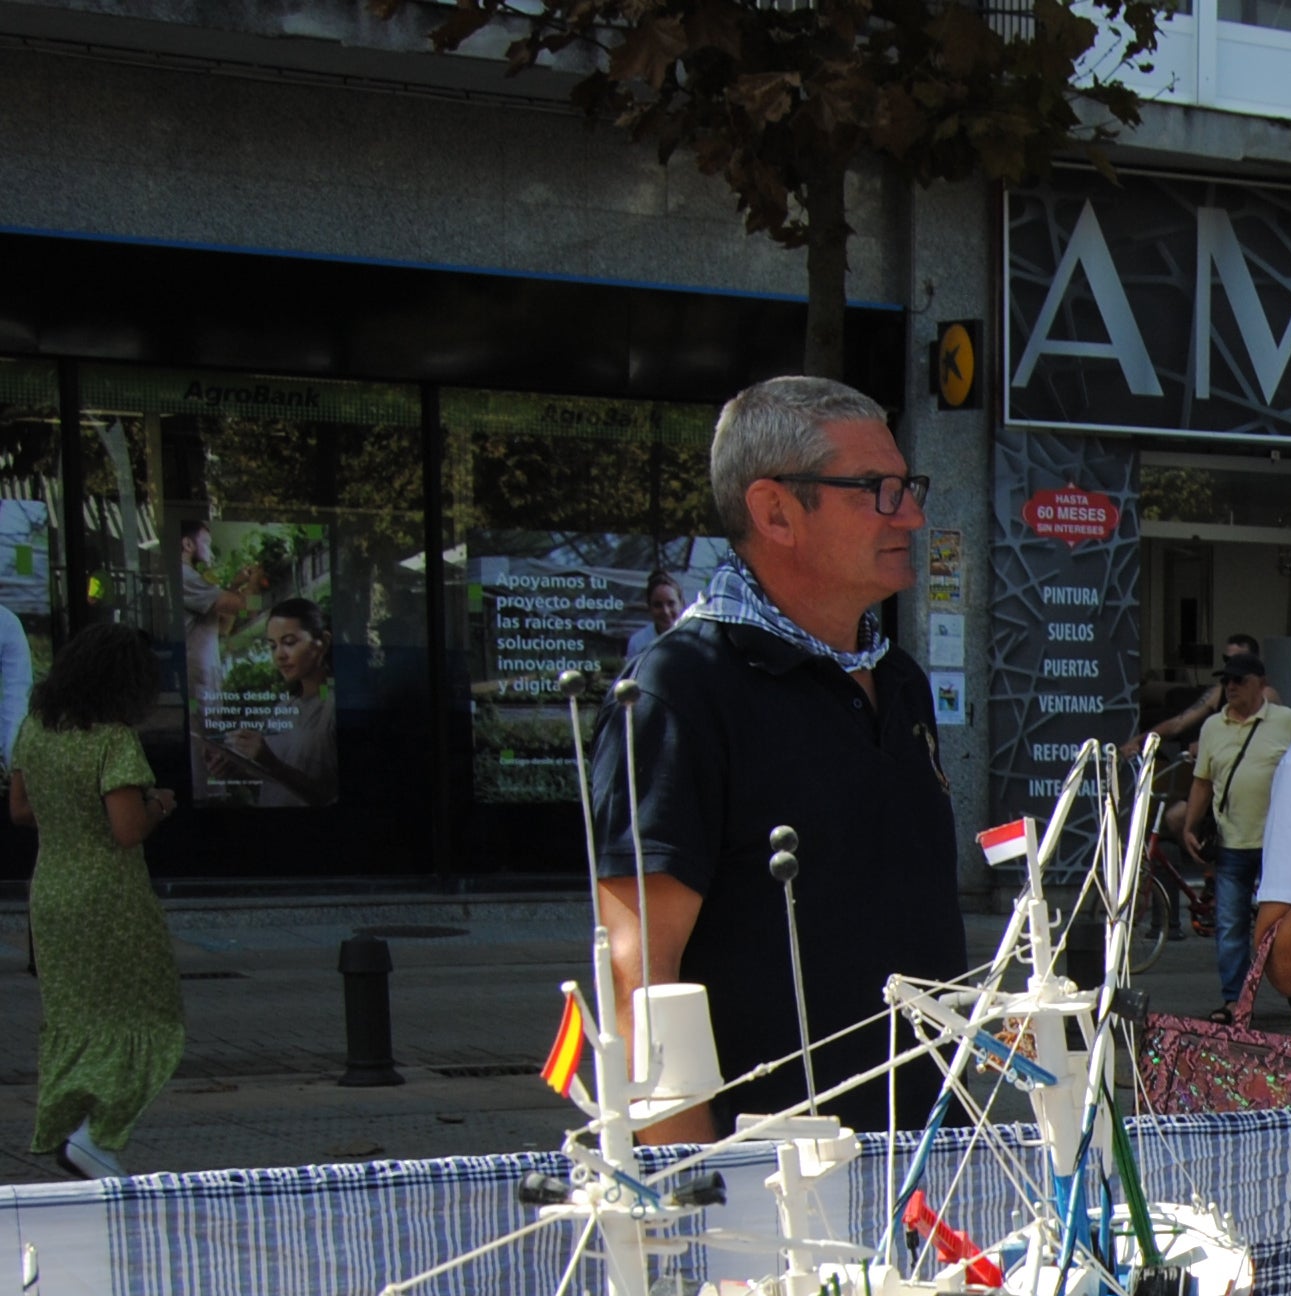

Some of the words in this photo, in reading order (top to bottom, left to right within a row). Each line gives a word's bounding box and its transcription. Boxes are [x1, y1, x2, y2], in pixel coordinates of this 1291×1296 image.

[183, 381, 320, 406] AgroBank
[1056, 494, 1088, 505] HASTA
[1037, 505, 1054, 519] 60
[1057, 506, 1106, 521] MESES
[1037, 522, 1052, 533] SIN
[1054, 524, 1104, 535] INTERESES
[496, 572, 585, 591] Apoyamos
[590, 574, 607, 589] tu
[496, 595, 570, 612] proyecto
[575, 594, 624, 610] desde
[1043, 586, 1099, 606] PINTURA
[496, 613, 520, 629] las
[576, 617, 606, 631] con
[1048, 622, 1095, 641] SUELOS
[496, 634, 584, 651] soluciones
[497, 654, 602, 672] innovadoras
[1043, 658, 1099, 677] PUERTAS
[498, 679, 508, 695] y
[513, 676, 561, 695] digita
[204, 689, 240, 701] Juntos
[242, 689, 277, 701] desde
[279, 689, 290, 701] el
[1039, 695, 1104, 713] VENTANAS
[204, 705, 241, 717] primer
[245, 706, 272, 717] paso
[274, 706, 300, 717] para
[204, 719, 238, 731] llegar
[240, 721, 265, 732] muy
[267, 719, 295, 732] lejos
